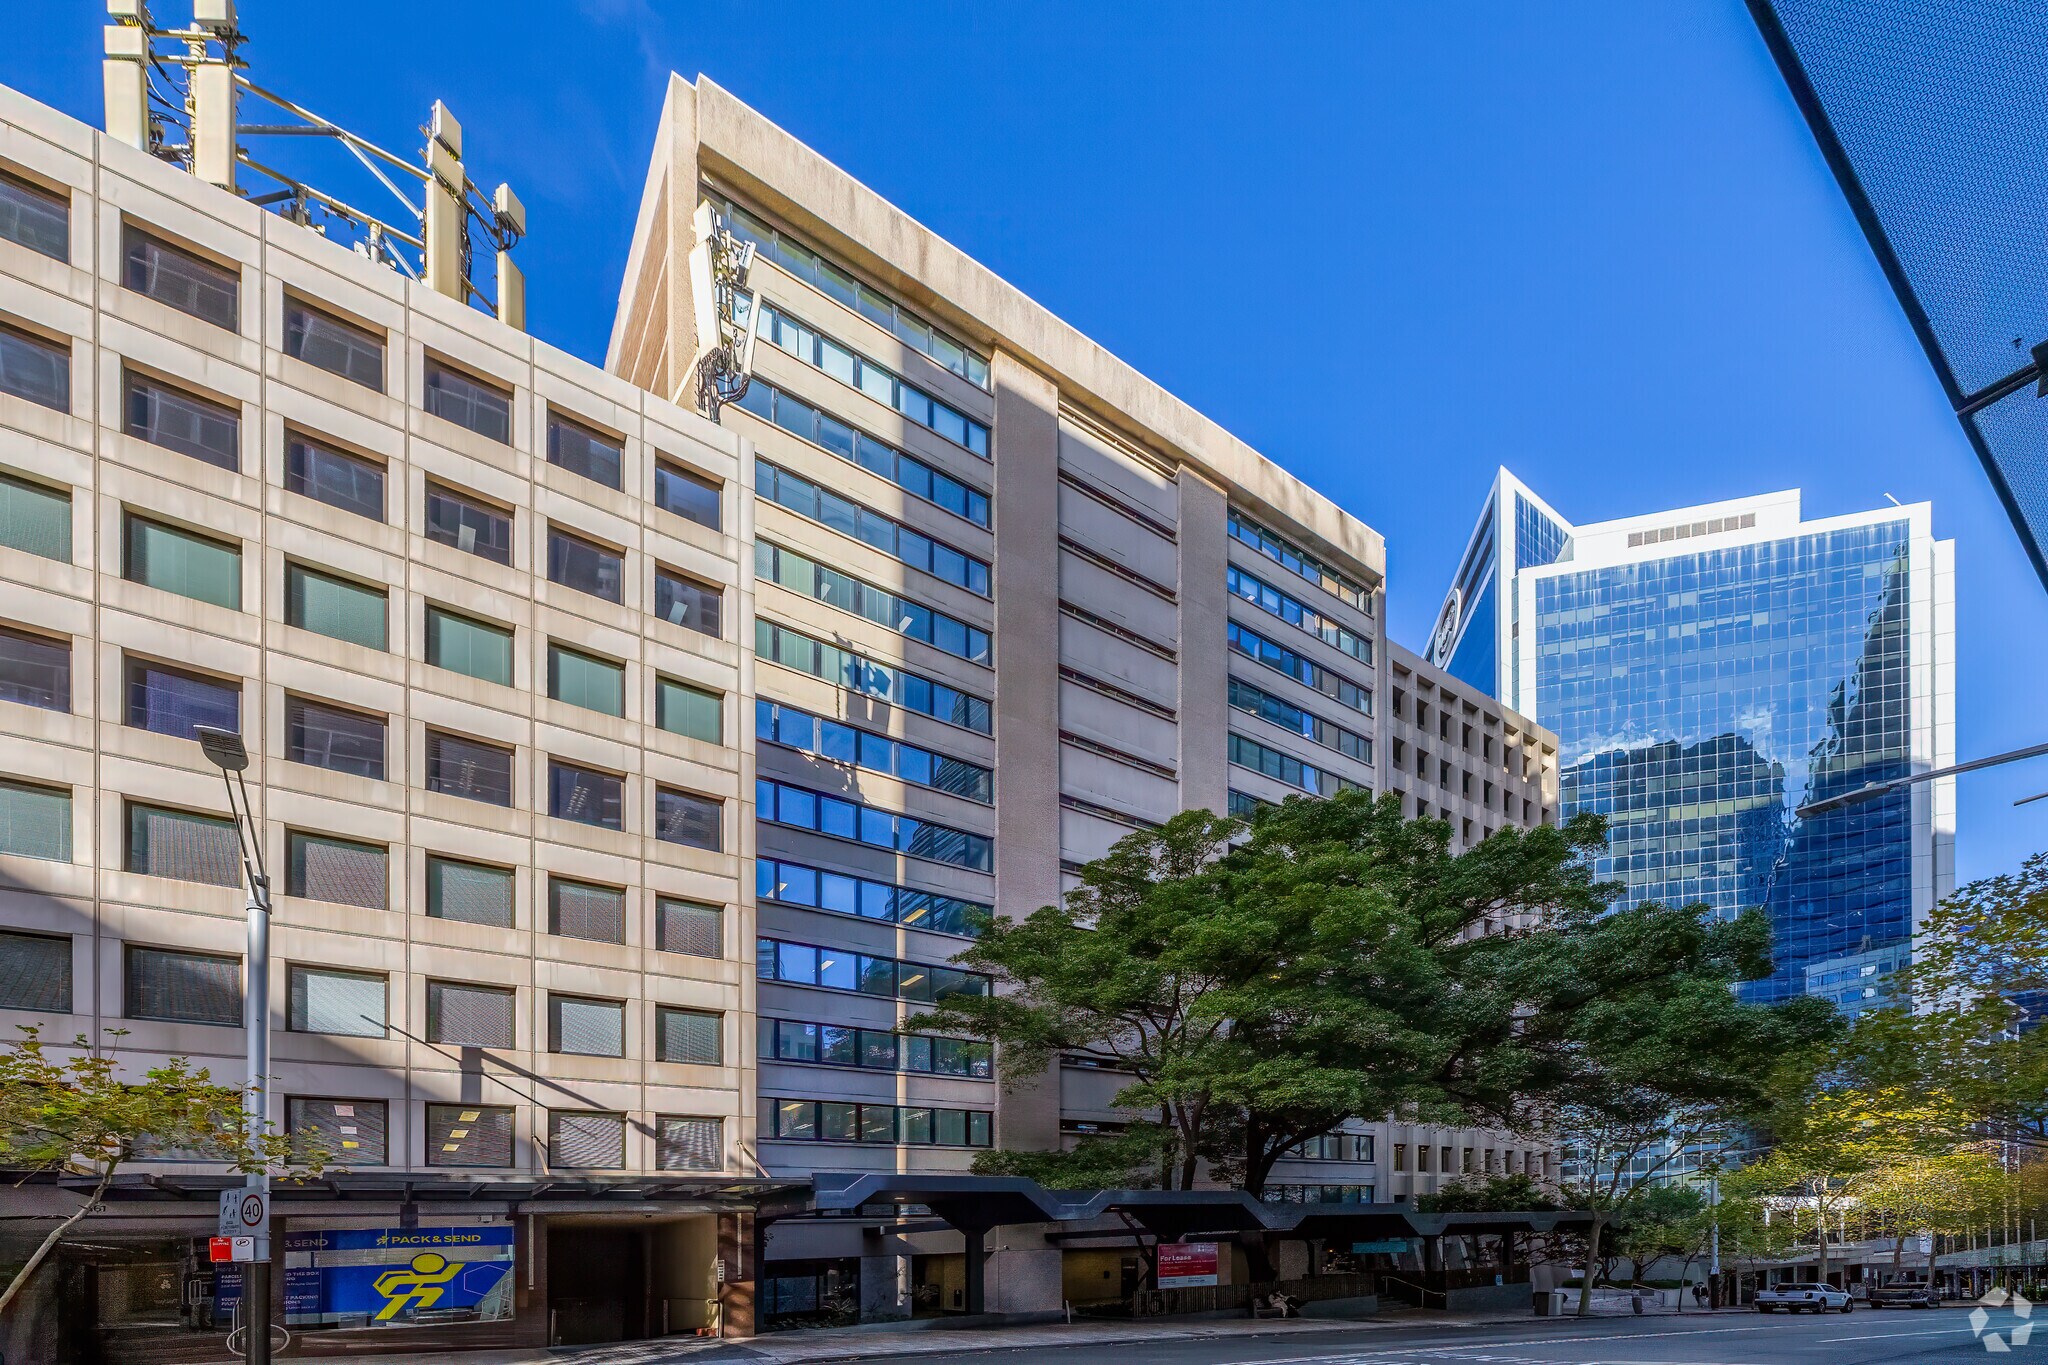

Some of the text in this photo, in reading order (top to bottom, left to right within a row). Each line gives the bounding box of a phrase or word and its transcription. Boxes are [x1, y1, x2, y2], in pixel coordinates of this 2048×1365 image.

[245, 1203, 259, 1217] 40
[293, 1238, 328, 1247] SEND
[391, 1235, 430, 1244] PACK
[444, 1234, 481, 1243] SEND
